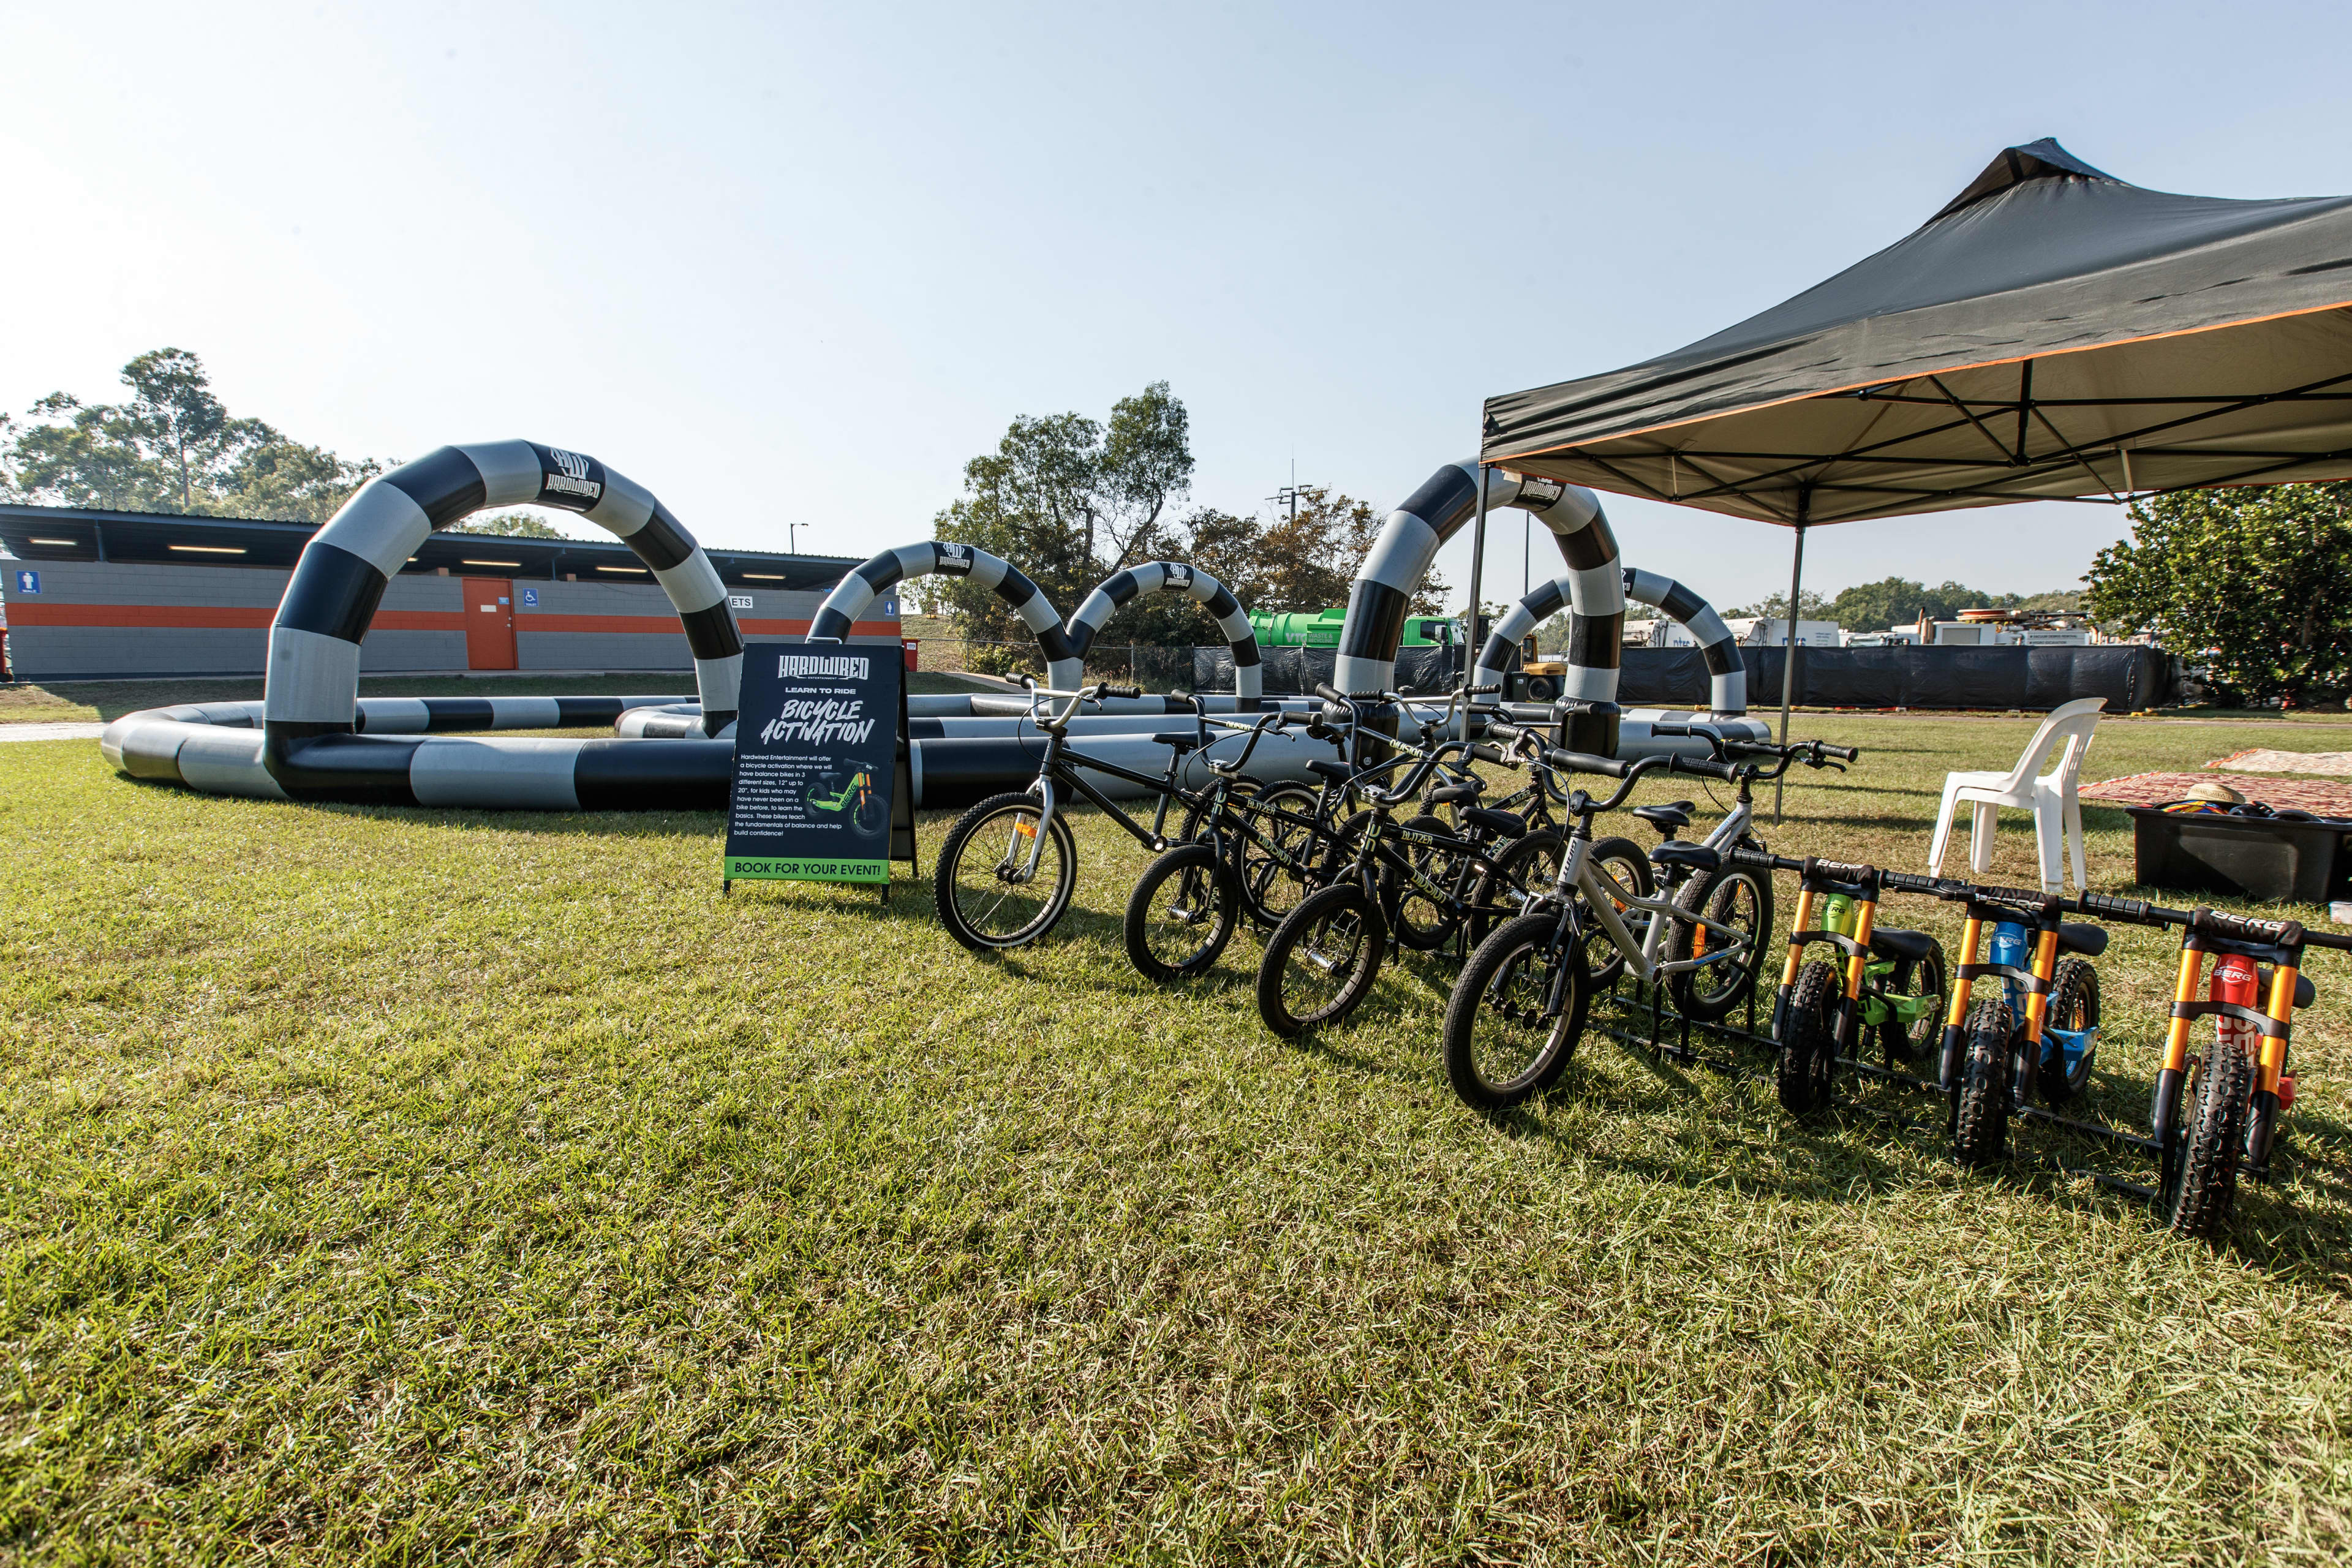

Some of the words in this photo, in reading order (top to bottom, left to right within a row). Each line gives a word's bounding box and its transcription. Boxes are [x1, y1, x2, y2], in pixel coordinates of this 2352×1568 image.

[546, 473, 600, 499] HARDWIRED
[1521, 480, 1561, 500] HARDWIRED
[939, 556, 970, 568] HARDWIRED
[778, 655, 869, 680] HARDWIRED
[781, 698, 863, 721] BICYCLE
[761, 718, 875, 746] ACTIVATION
[840, 783, 858, 807] BERG
[1510, 790, 1531, 805] BLITZER
[1247, 799, 1276, 815] BLITZER
[1401, 830, 1433, 845] BLITZER
[735, 862, 772, 873] BOOK
[775, 862, 799, 874] FOR
[803, 863, 837, 875] YOUR
[840, 864, 881, 875] EVENT!
[1563, 839, 1577, 880] GIANT
[2210, 910, 2286, 932] BERG
[1991, 935, 2021, 946] BERG
[2214, 970, 2253, 981] BERG
